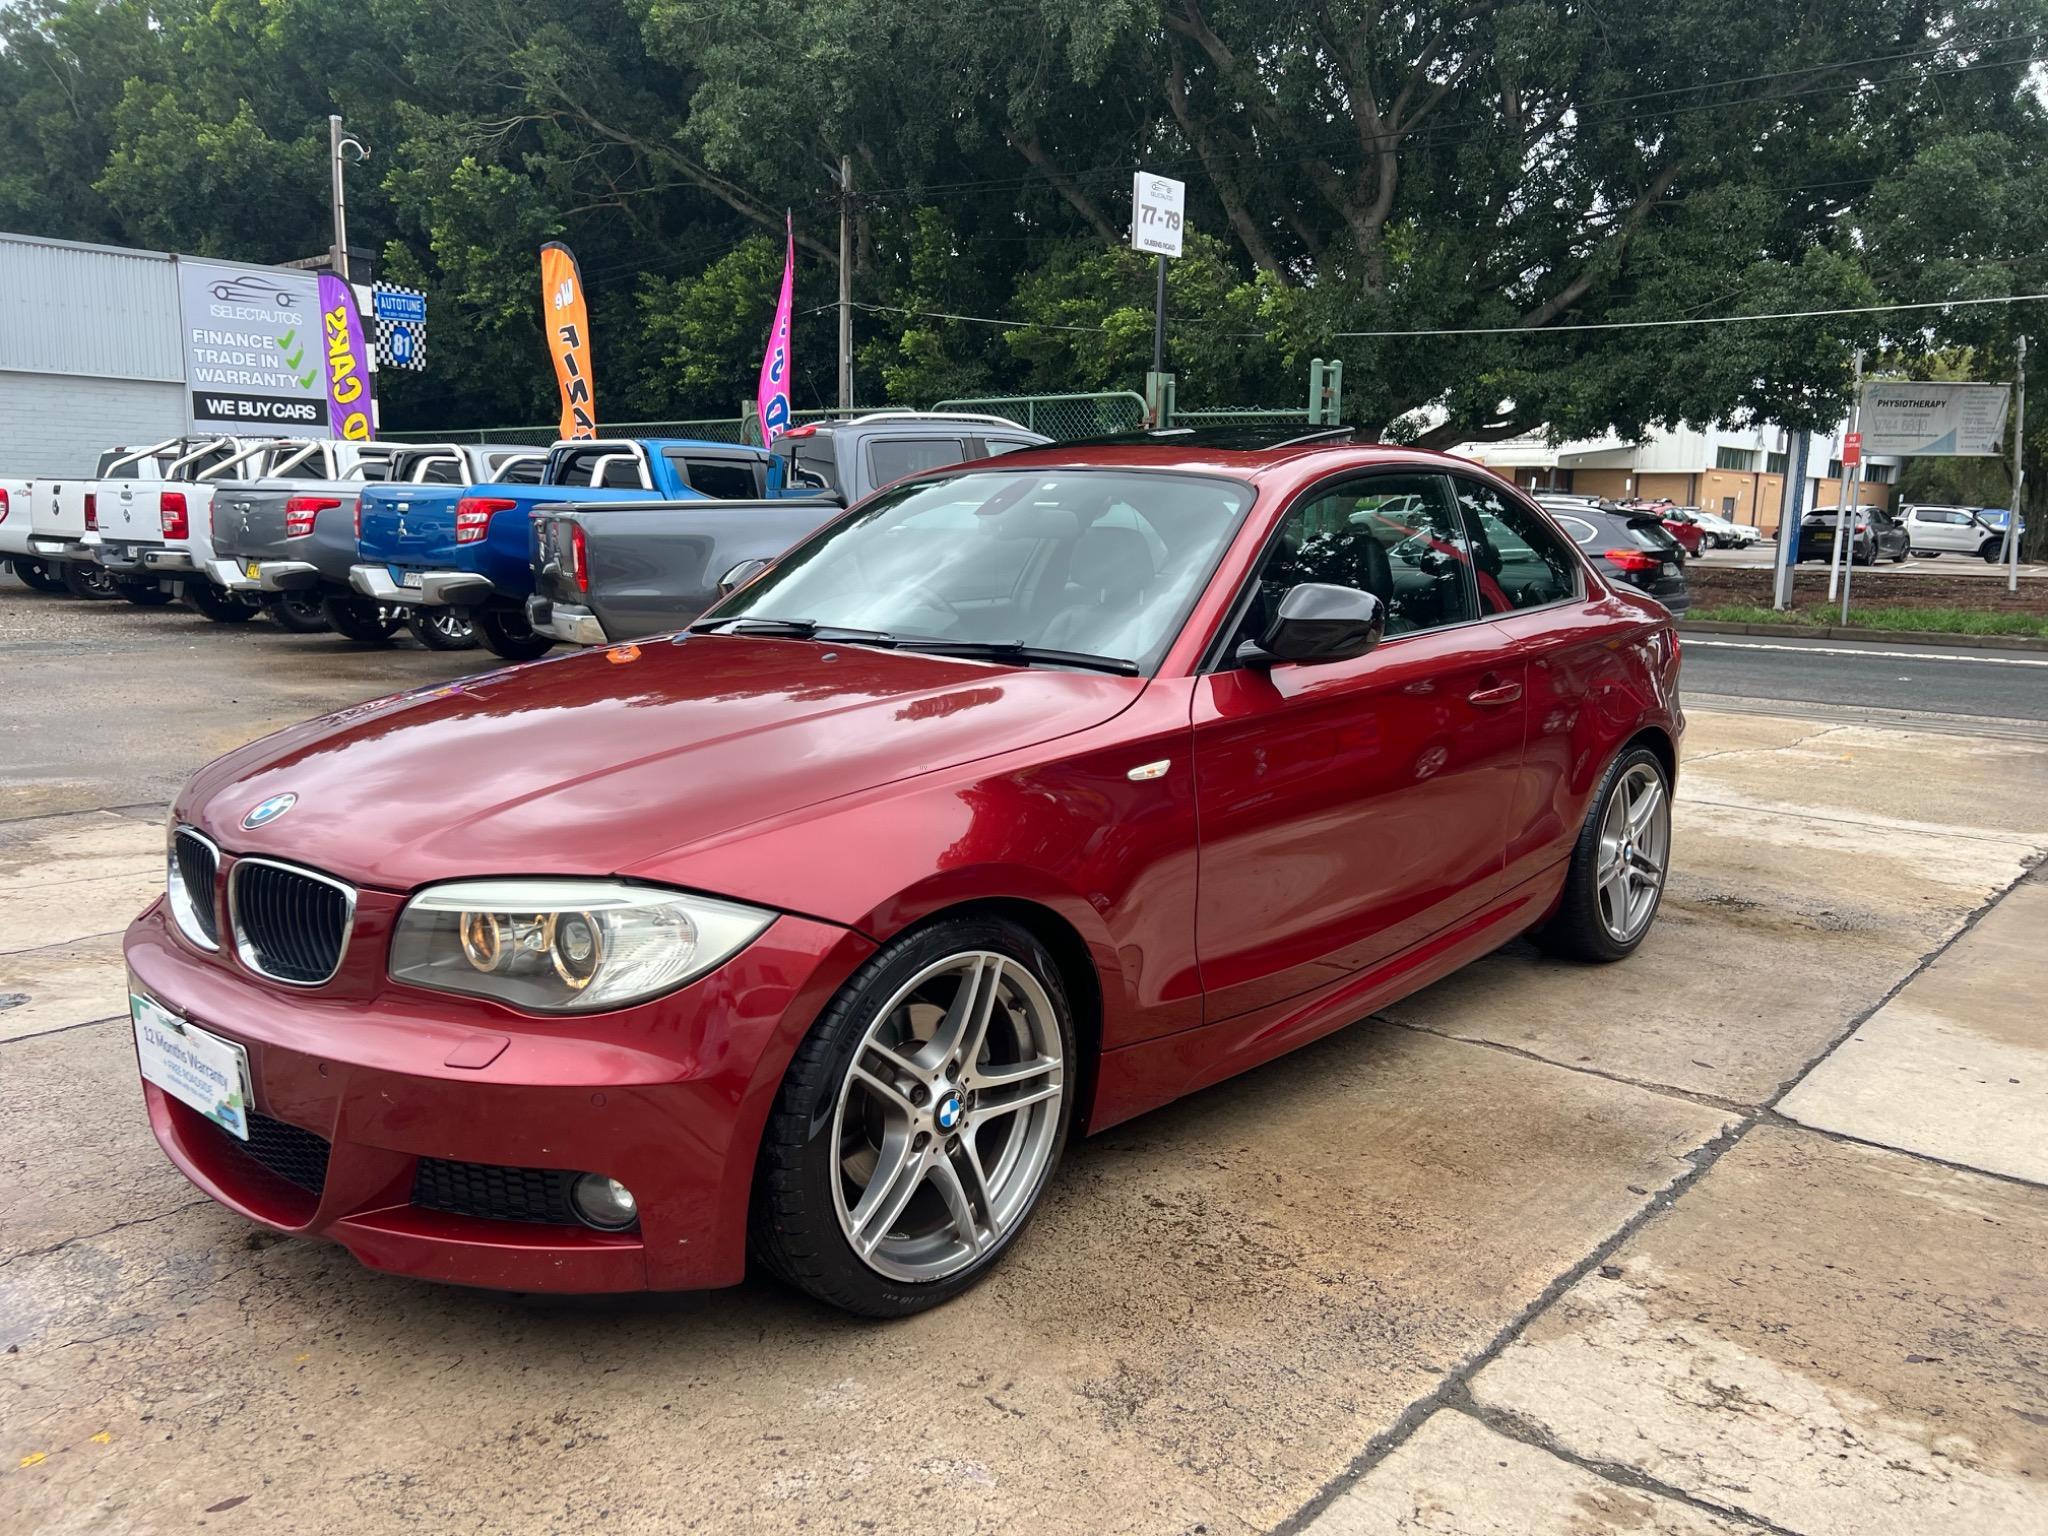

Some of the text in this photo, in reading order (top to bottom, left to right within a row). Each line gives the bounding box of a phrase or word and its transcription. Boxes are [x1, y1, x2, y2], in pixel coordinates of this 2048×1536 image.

[380, 296, 422, 313] AUTOTUNE
[192, 328, 274, 350] FINANCE
[393, 333, 410, 358] 81
[193, 348, 279, 369] TRADE IN
[194, 367, 299, 390] WARRANTY
[206, 399, 317, 420] WE BUY CARS
[1877, 399, 1947, 409] PHYSIOTHERAPY
[186, 1049, 229, 1092] Warranty
